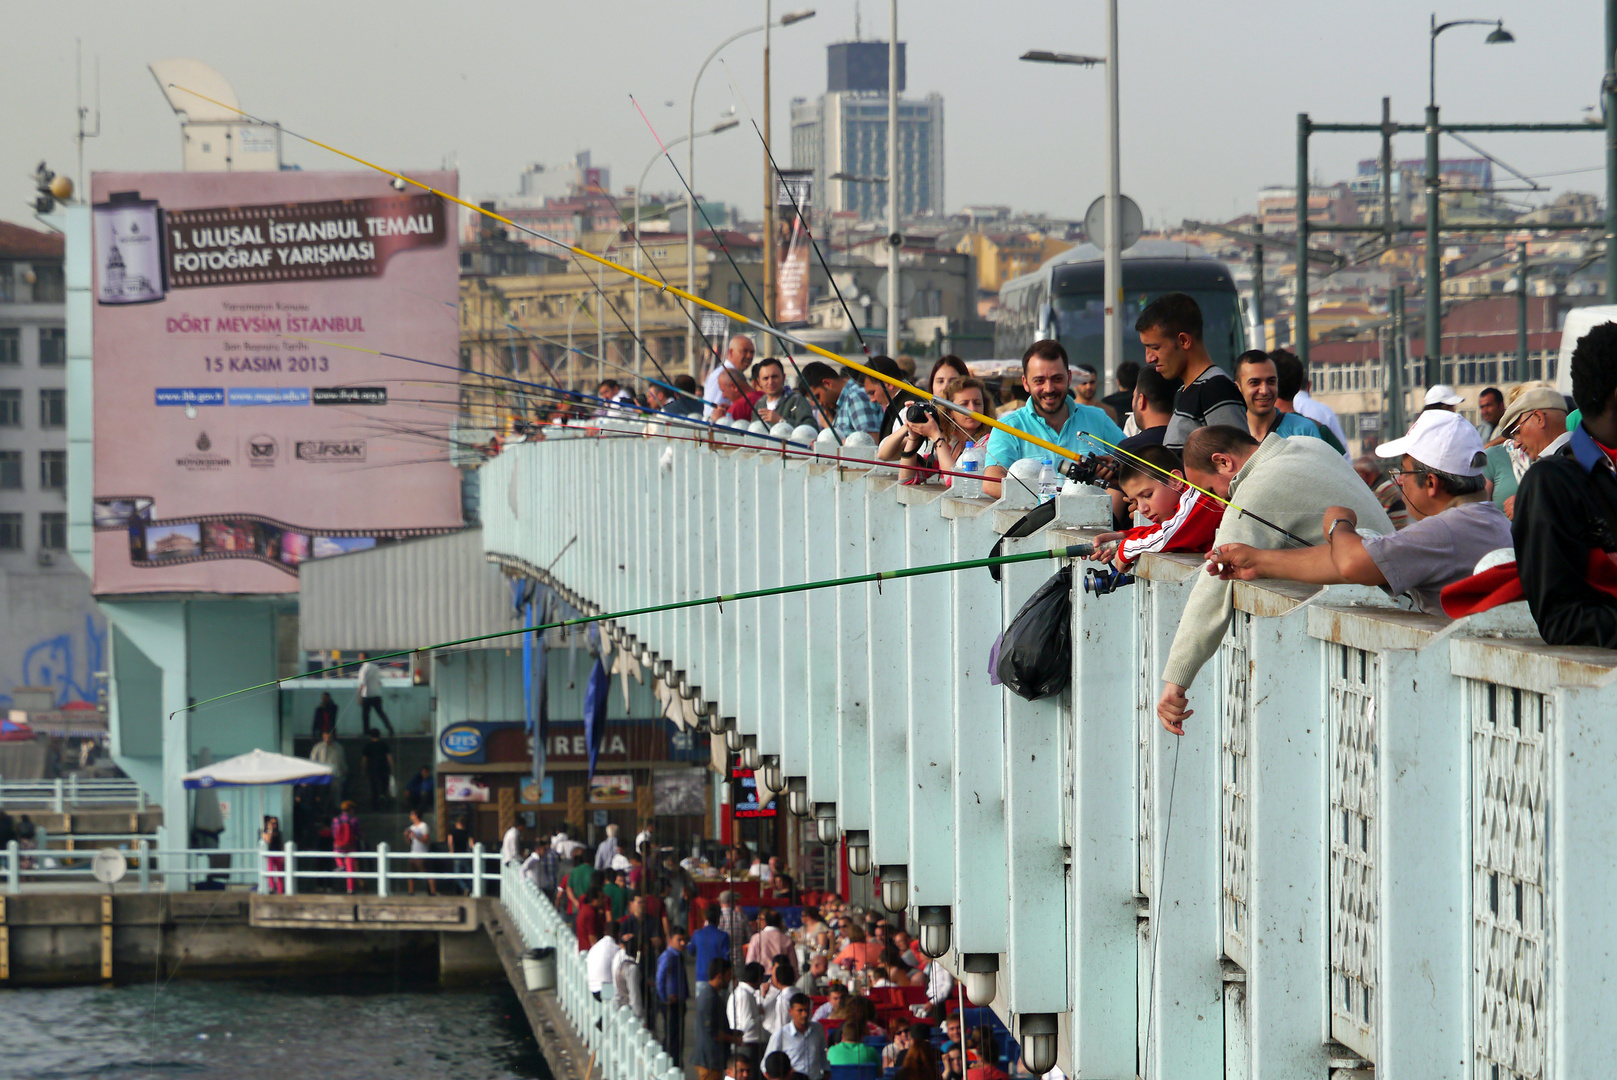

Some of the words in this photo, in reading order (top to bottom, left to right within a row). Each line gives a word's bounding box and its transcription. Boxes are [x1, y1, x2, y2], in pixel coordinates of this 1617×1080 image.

[172, 230, 188, 249] 1.
[192, 225, 266, 248] ULUSAL
[268, 218, 363, 243] İSTANBUL
[365, 213, 434, 237] TEMALI
[173, 246, 273, 272] FOTOĞRAF
[276, 241, 375, 266] YARIŞMASI
[166, 312, 211, 333] DÖRT
[216, 313, 282, 333] MEVSİM
[286, 312, 365, 332] İSTANBUL
[204, 357, 224, 372] 15
[229, 357, 282, 372] KASIM
[288, 357, 329, 372] 2013
